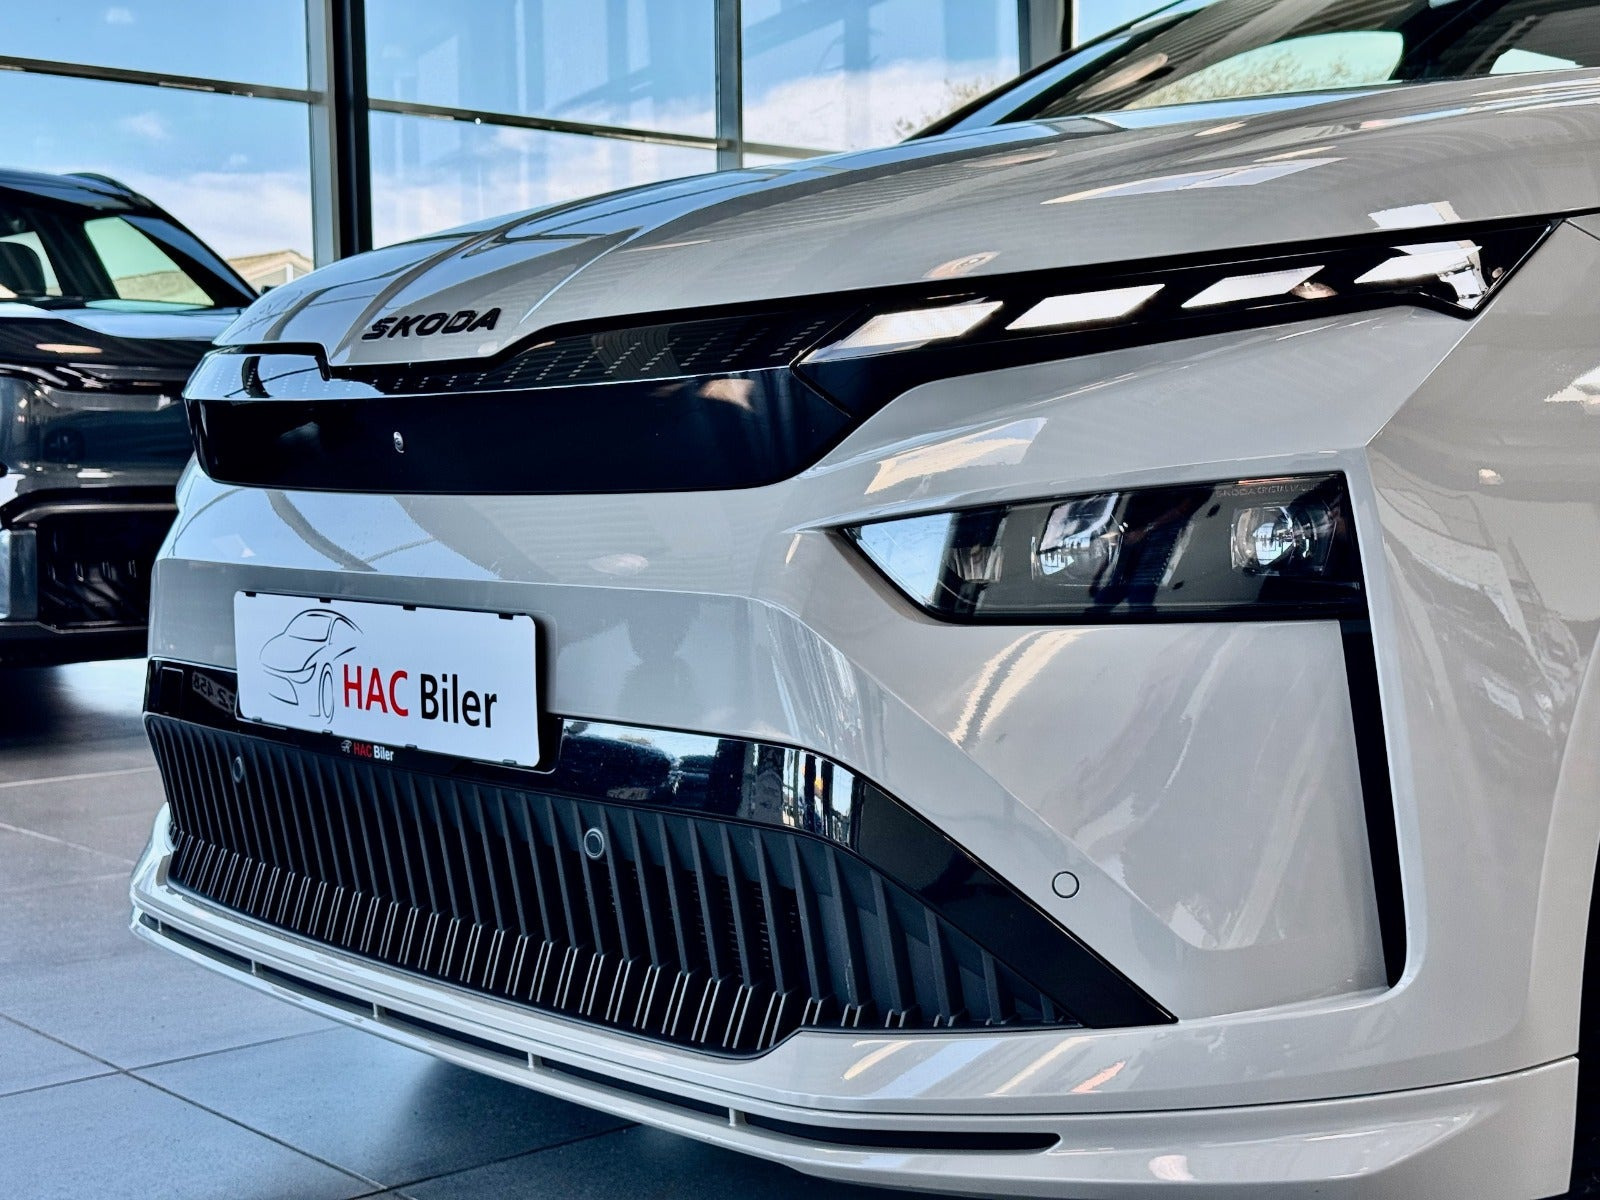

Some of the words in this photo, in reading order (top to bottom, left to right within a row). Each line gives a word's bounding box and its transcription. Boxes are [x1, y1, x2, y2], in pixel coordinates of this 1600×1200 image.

[361, 307, 502, 341] SKODA
[343, 663, 409, 717] HAC
[420, 673, 498, 729] Biler
[353, 742, 373, 758] HAC
[373, 744, 395, 762] Biler
